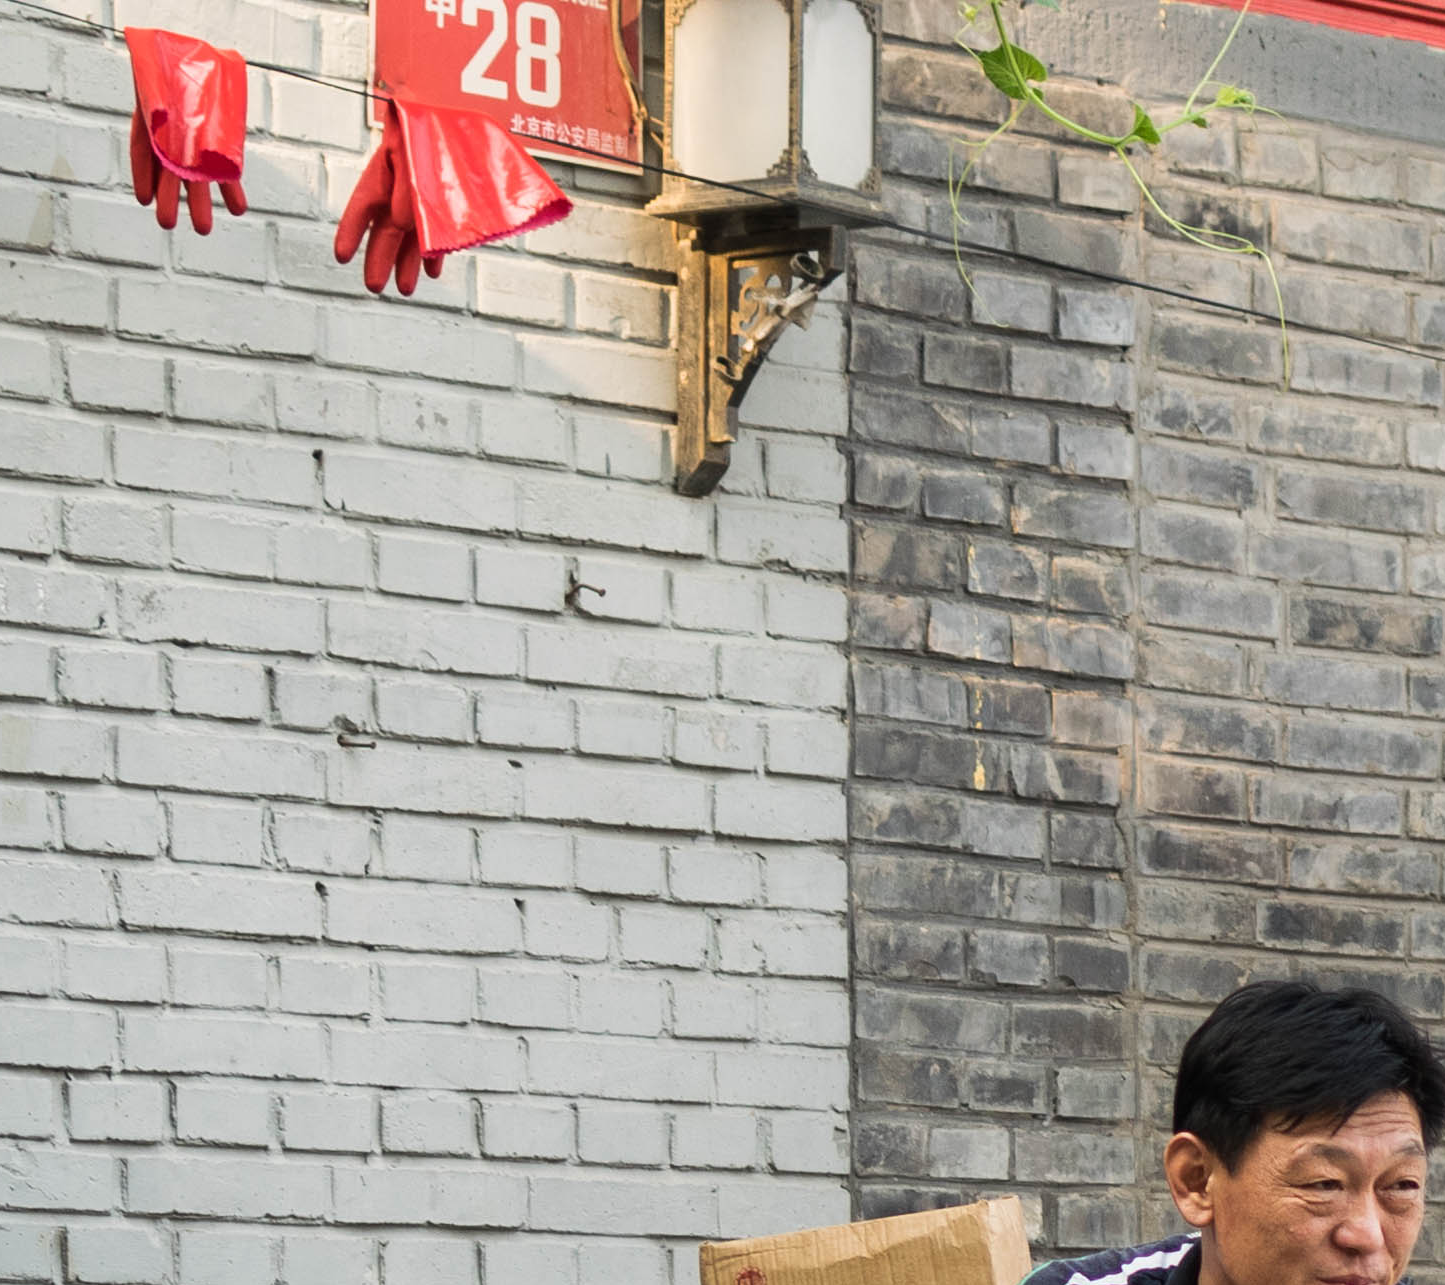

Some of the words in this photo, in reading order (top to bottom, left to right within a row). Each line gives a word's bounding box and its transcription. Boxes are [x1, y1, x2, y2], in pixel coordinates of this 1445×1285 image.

[460, 0, 561, 109] 28
[510, 113, 629, 158] 北京市公安局监制
